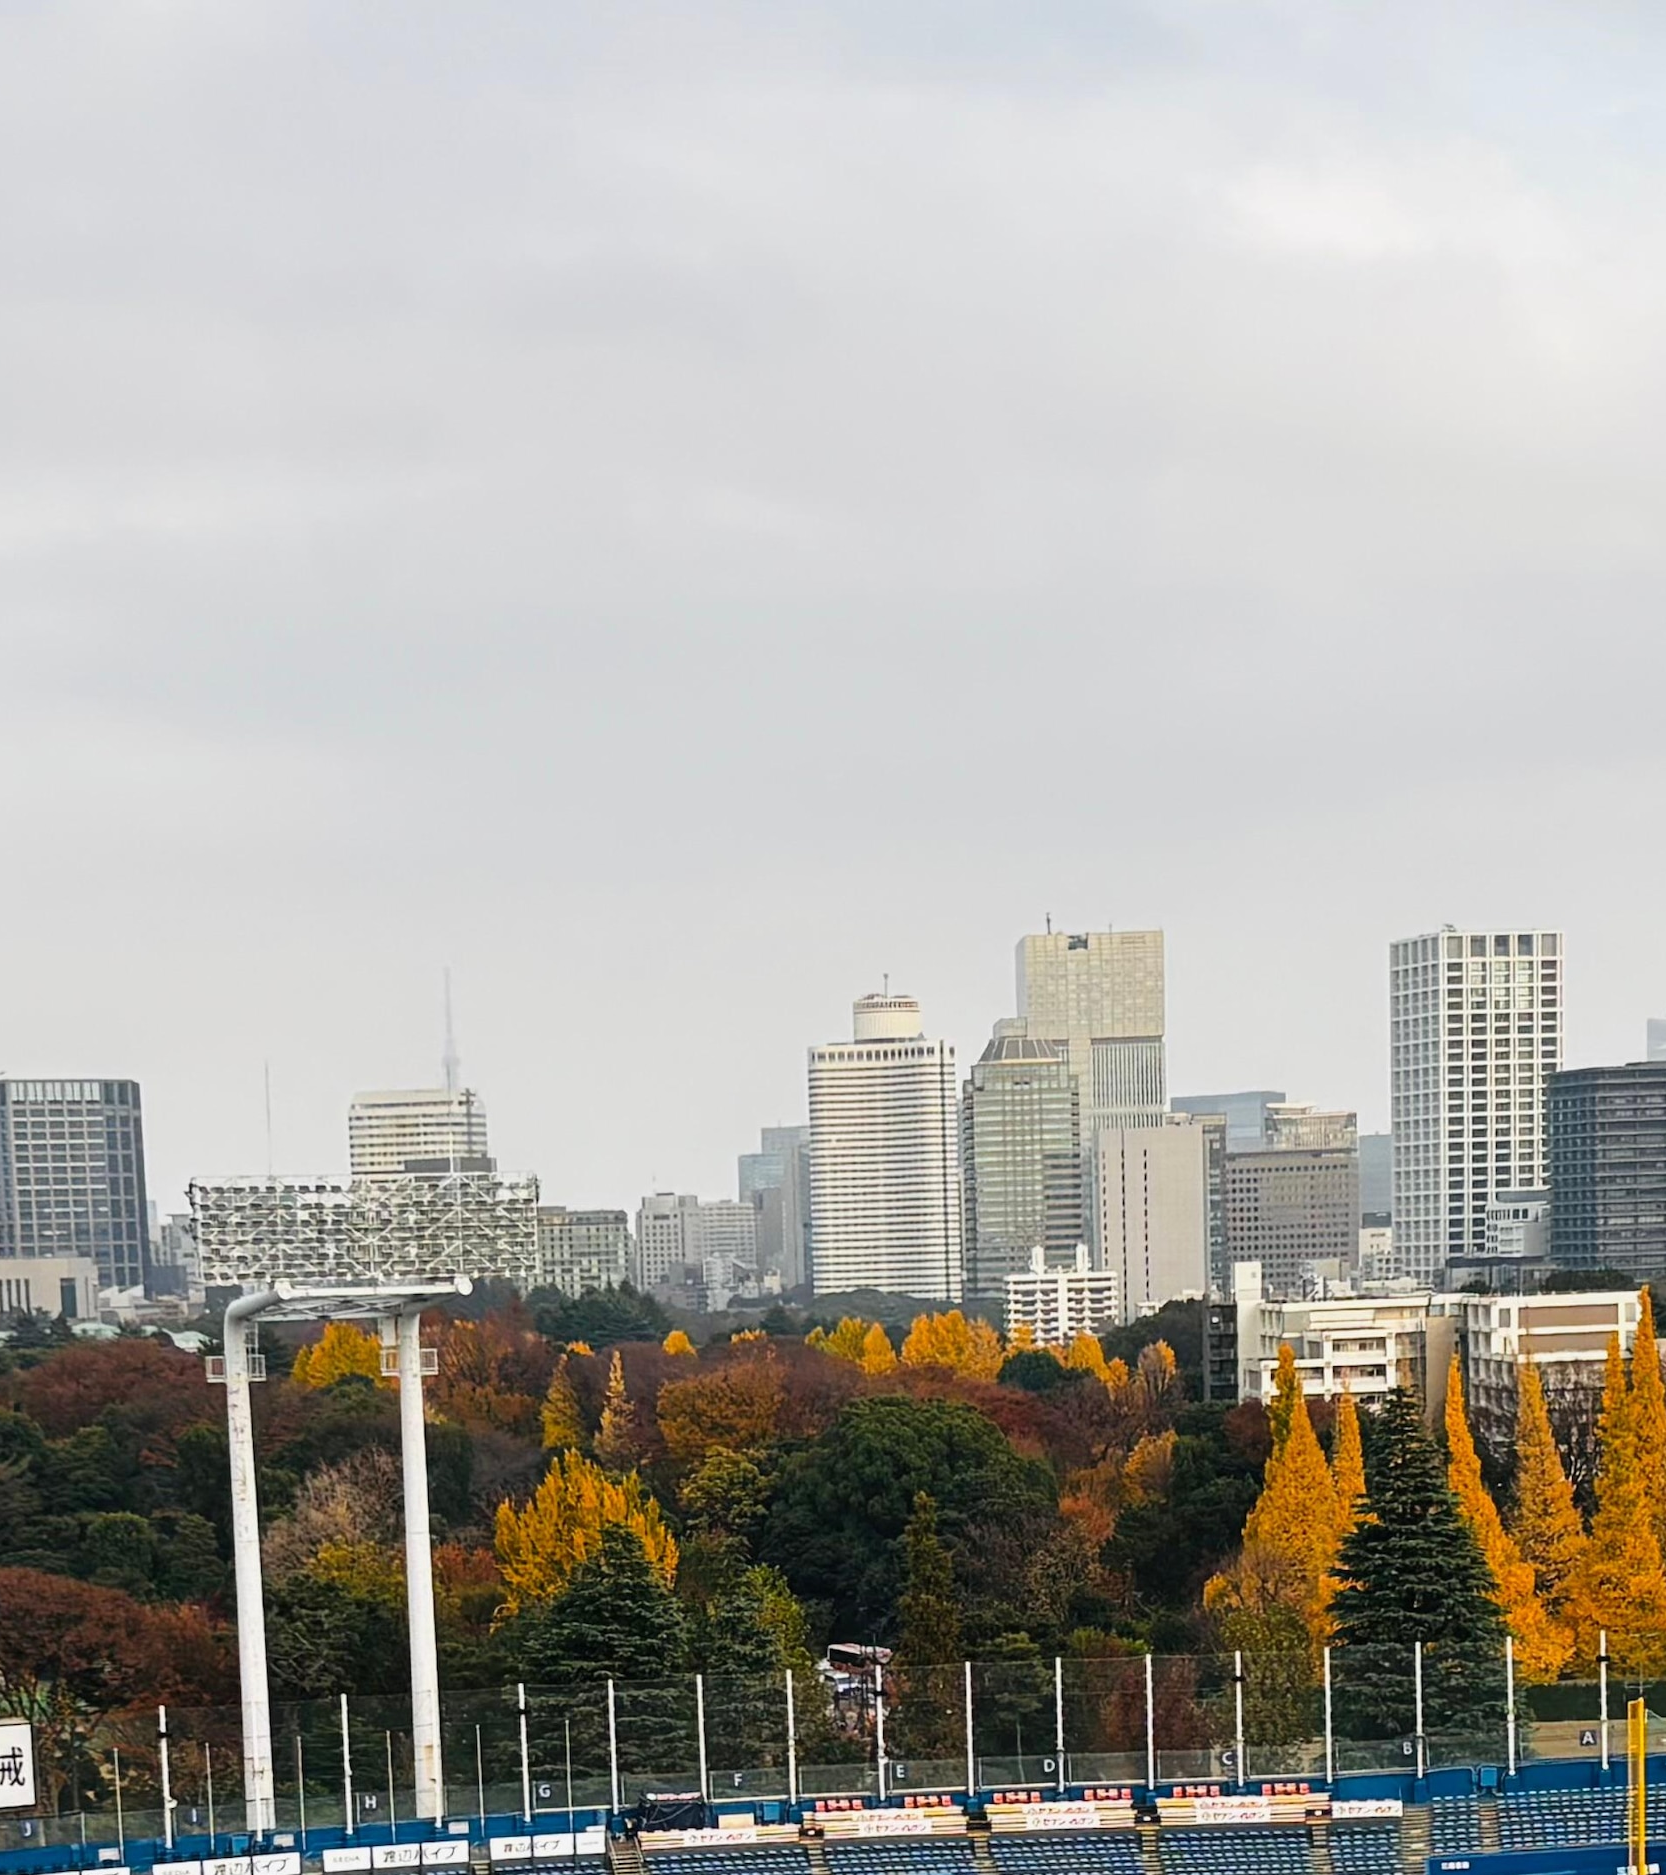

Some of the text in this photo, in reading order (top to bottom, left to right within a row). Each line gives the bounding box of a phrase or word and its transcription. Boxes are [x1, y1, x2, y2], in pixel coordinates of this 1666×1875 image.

[1582, 1731, 1594, 1745] A
[1402, 1741, 1412, 1755] B
[1043, 1758, 1056, 1773] D
[1221, 1751, 1233, 1766] C
[896, 1764, 906, 1779] E
[734, 1773, 743, 1788] F
[539, 1785, 551, 1798] G
[364, 1795, 377, 1809] H
